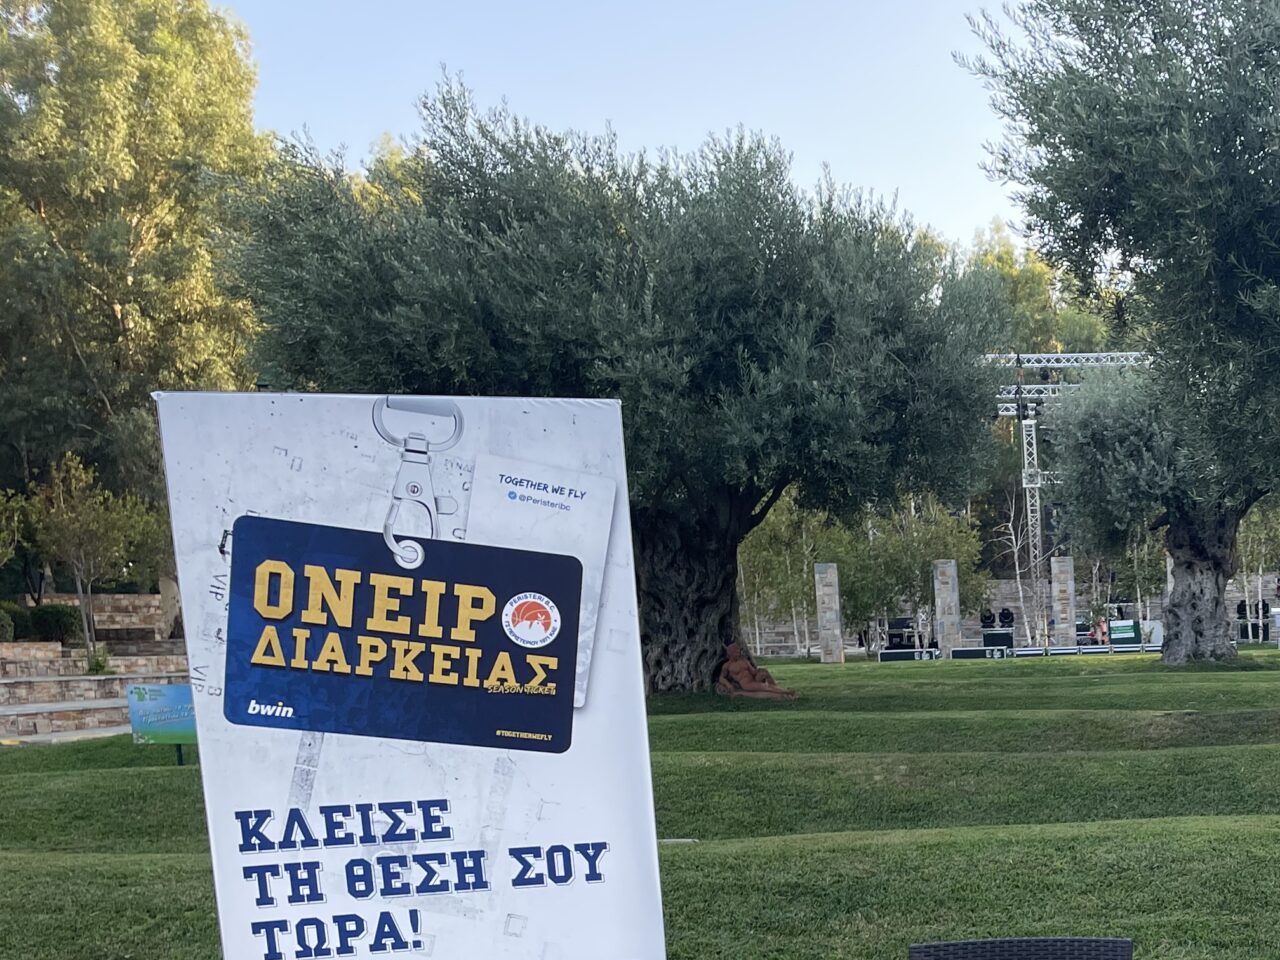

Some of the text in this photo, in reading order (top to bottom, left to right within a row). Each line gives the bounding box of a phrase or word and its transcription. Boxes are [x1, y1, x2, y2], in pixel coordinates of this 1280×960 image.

[498, 473, 587, 500] TOGETHER WE FLY
[518, 494, 571, 512] @Peristeribc
[252, 559, 497, 642] ΟΝΕΙΡ
[250, 624, 559, 694] ΔΙΑΡΚΕΙΑΣ
[247, 699, 294, 717] bwin
[487, 684, 556, 695] SEASON TICKET
[234, 798, 454, 853] ΚΛΕΙΣΕ
[243, 841, 610, 908] ΤΗ ΘΕΣΗ ΣΟΥ
